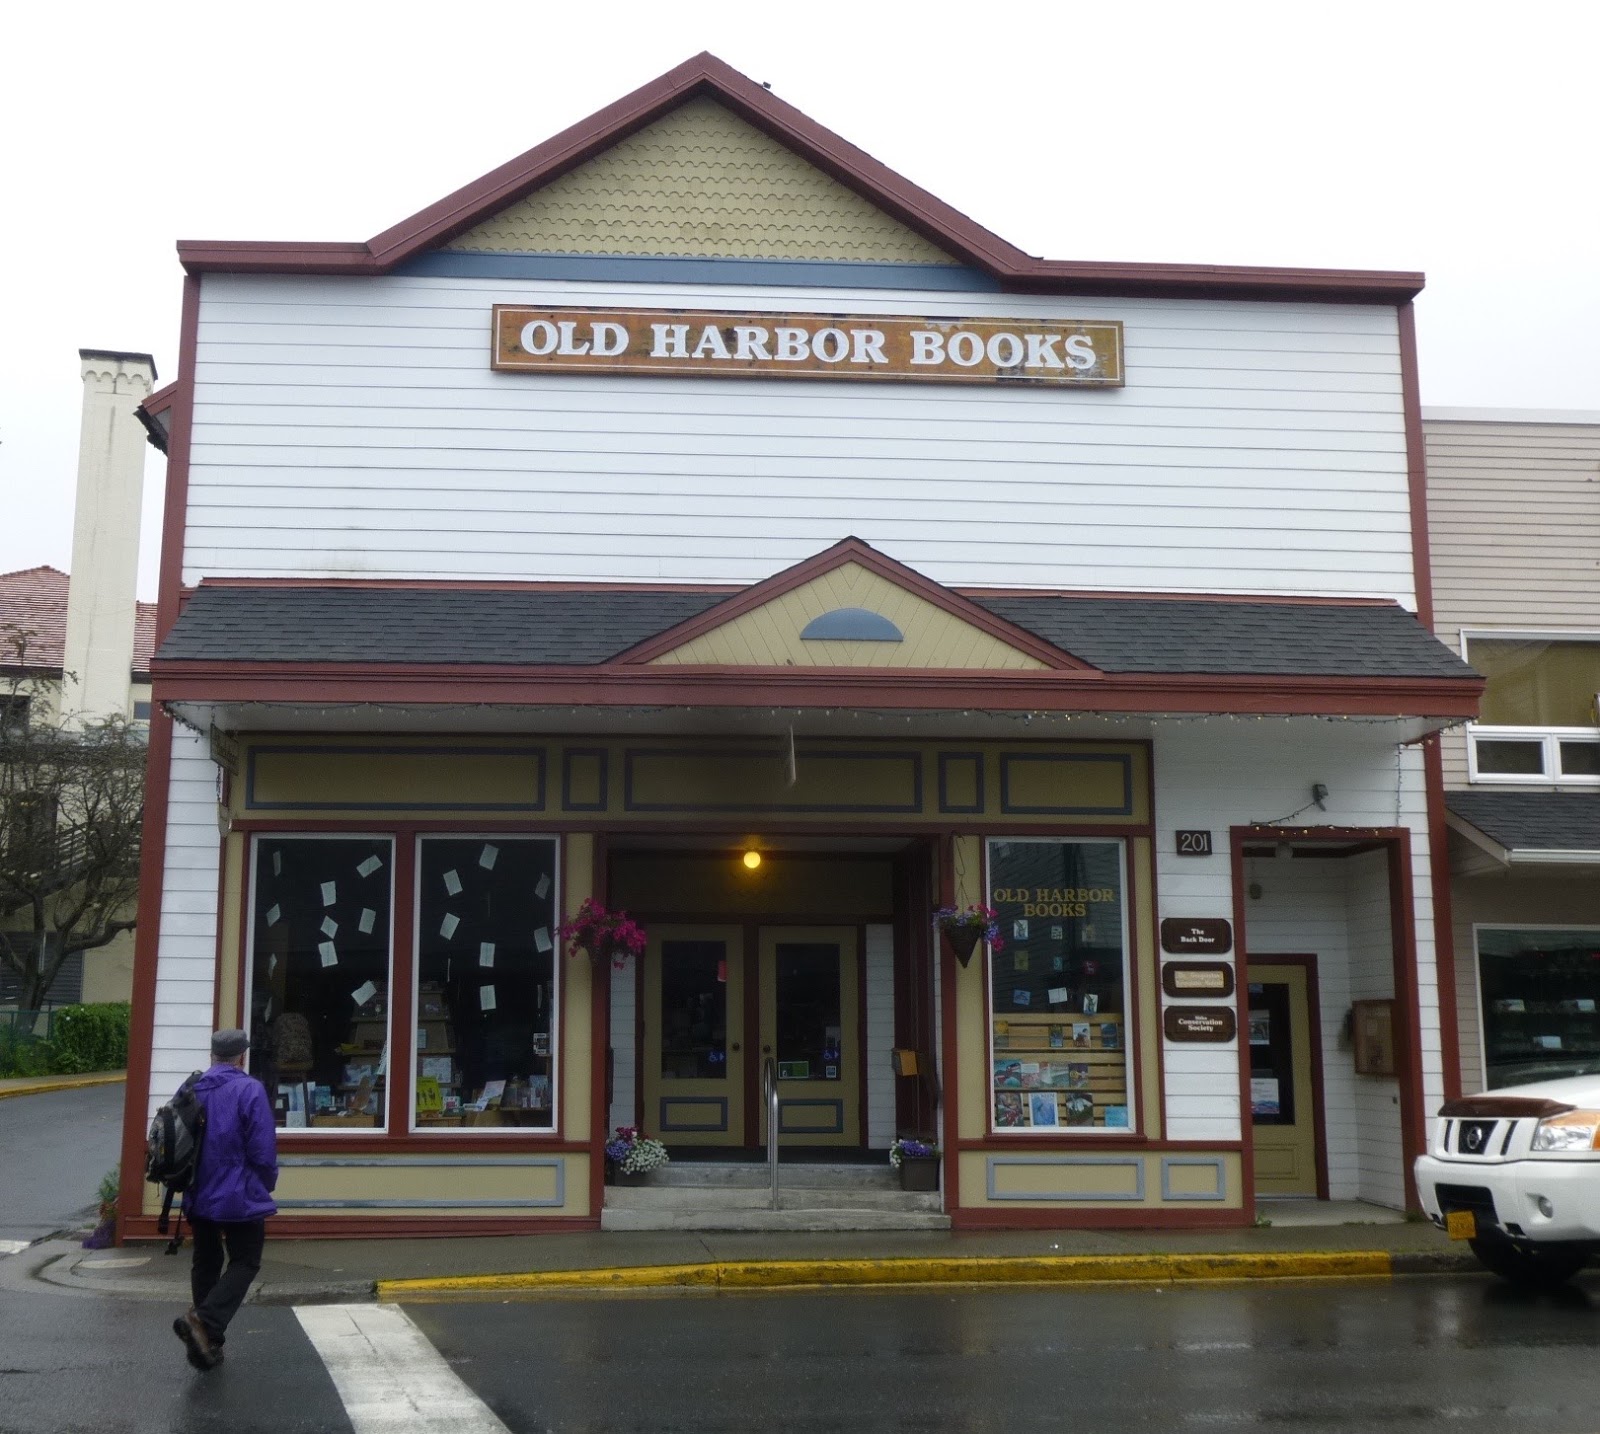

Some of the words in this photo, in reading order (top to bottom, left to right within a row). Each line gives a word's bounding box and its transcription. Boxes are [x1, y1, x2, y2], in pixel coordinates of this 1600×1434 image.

[520, 320, 630, 356] OLD
[649, 323, 889, 364] HARBOR
[909, 330, 1097, 370] BOOKS
[1181, 833, 1209, 852] 201
[993, 888, 1030, 902] OLD
[1036, 888, 1115, 903] HARBOR
[1023, 903, 1087, 917] BOOKS
[1178, 1018, 1223, 1026] Conservation
[1188, 1025, 1214, 1033] Society
